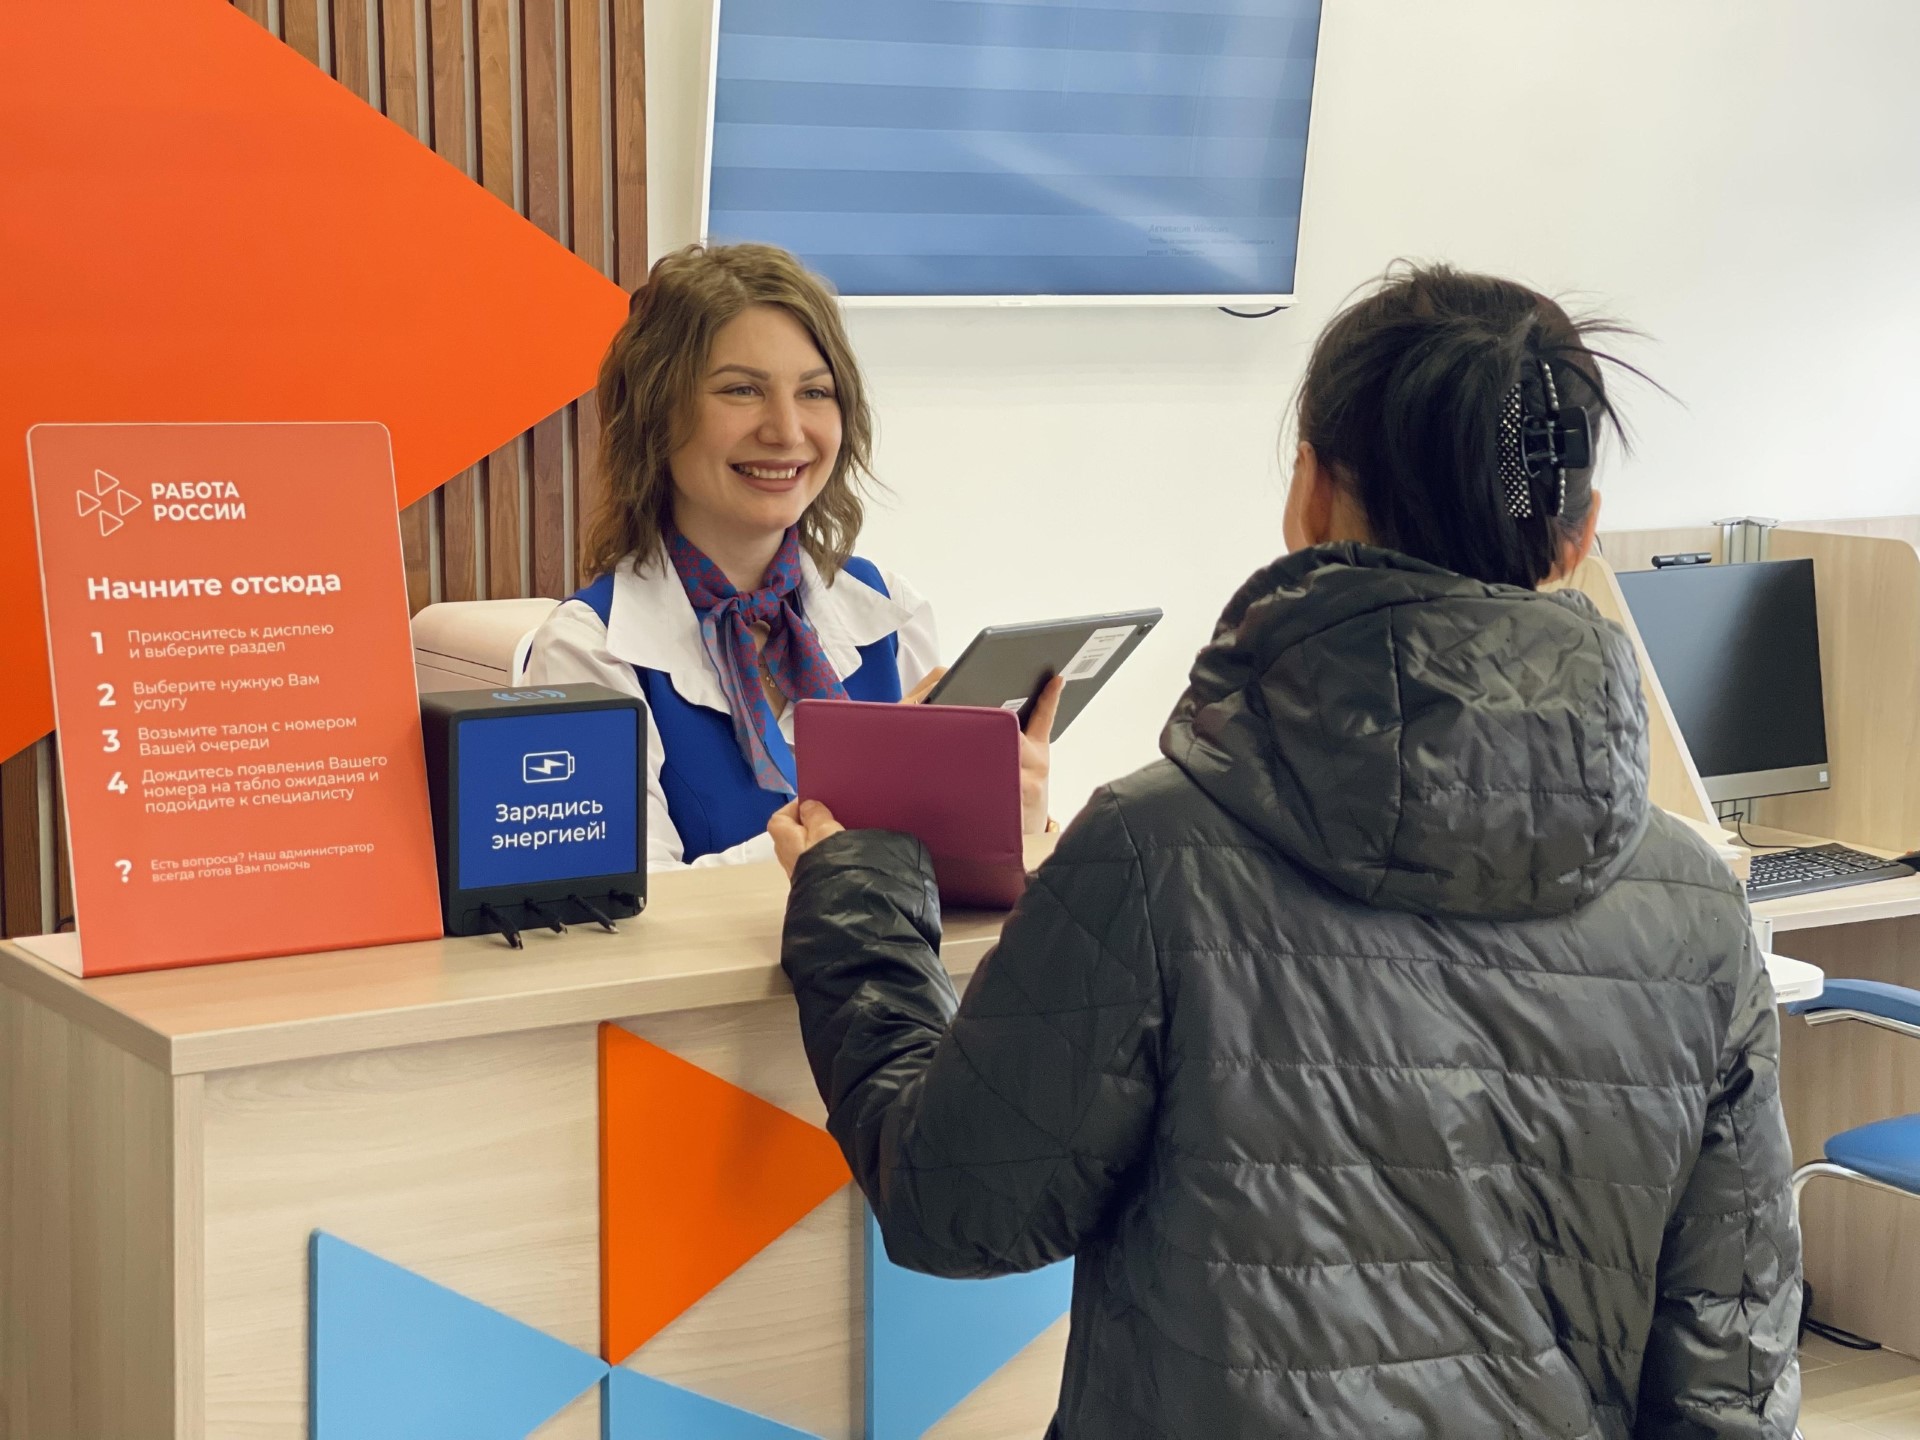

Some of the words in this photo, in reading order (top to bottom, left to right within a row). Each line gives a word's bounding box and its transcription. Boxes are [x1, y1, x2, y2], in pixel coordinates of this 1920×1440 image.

[151, 482, 239, 499] РАБОТА
[153, 503, 246, 521] РОССИИ
[88, 577, 222, 600] Начните
[231, 573, 341, 595] отсюда
[91, 632, 104, 654] 1
[128, 629, 246, 645] Прикоснитесь
[250, 628, 260, 638] к
[262, 624, 334, 638] дисплею
[129, 648, 140, 658] и
[145, 642, 225, 658] выберите
[230, 640, 286, 656] раздел
[96, 683, 116, 706] 2
[133, 680, 216, 695] Выберите
[220, 676, 284, 692] нужную
[288, 674, 320, 686] Вам
[134, 696, 188, 713] услугу
[138, 726, 217, 740] Возьмите
[221, 722, 268, 736] талон
[272, 722, 281, 732] с
[284, 717, 357, 731] номером
[102, 729, 120, 752] 3
[140, 740, 196, 756] Вашей
[200, 737, 270, 752] очереди
[142, 768, 234, 784] Дождитесь
[237, 760, 324, 775] появления
[329, 755, 388, 770] Вашего
[106, 772, 128, 794] 4
[144, 782, 207, 798] номера
[211, 782, 230, 793] на
[235, 778, 281, 792] табло
[285, 772, 365, 788] ожидания
[369, 771, 379, 782] и
[146, 794, 235, 814] подойдите
[240, 796, 248, 806] к
[252, 788, 354, 806] специалисту
[495, 800, 603, 824] Зарядись
[492, 821, 606, 849] энергией!
[151, 860, 179, 870] Есть
[182, 853, 244, 868] вопросы?
[249, 852, 276, 861] Наш
[279, 842, 374, 860] администратор
[152, 870, 195, 882] всегда
[198, 867, 232, 878] готов
[235, 864, 261, 875] Вам
[264, 861, 310, 872] помочь
